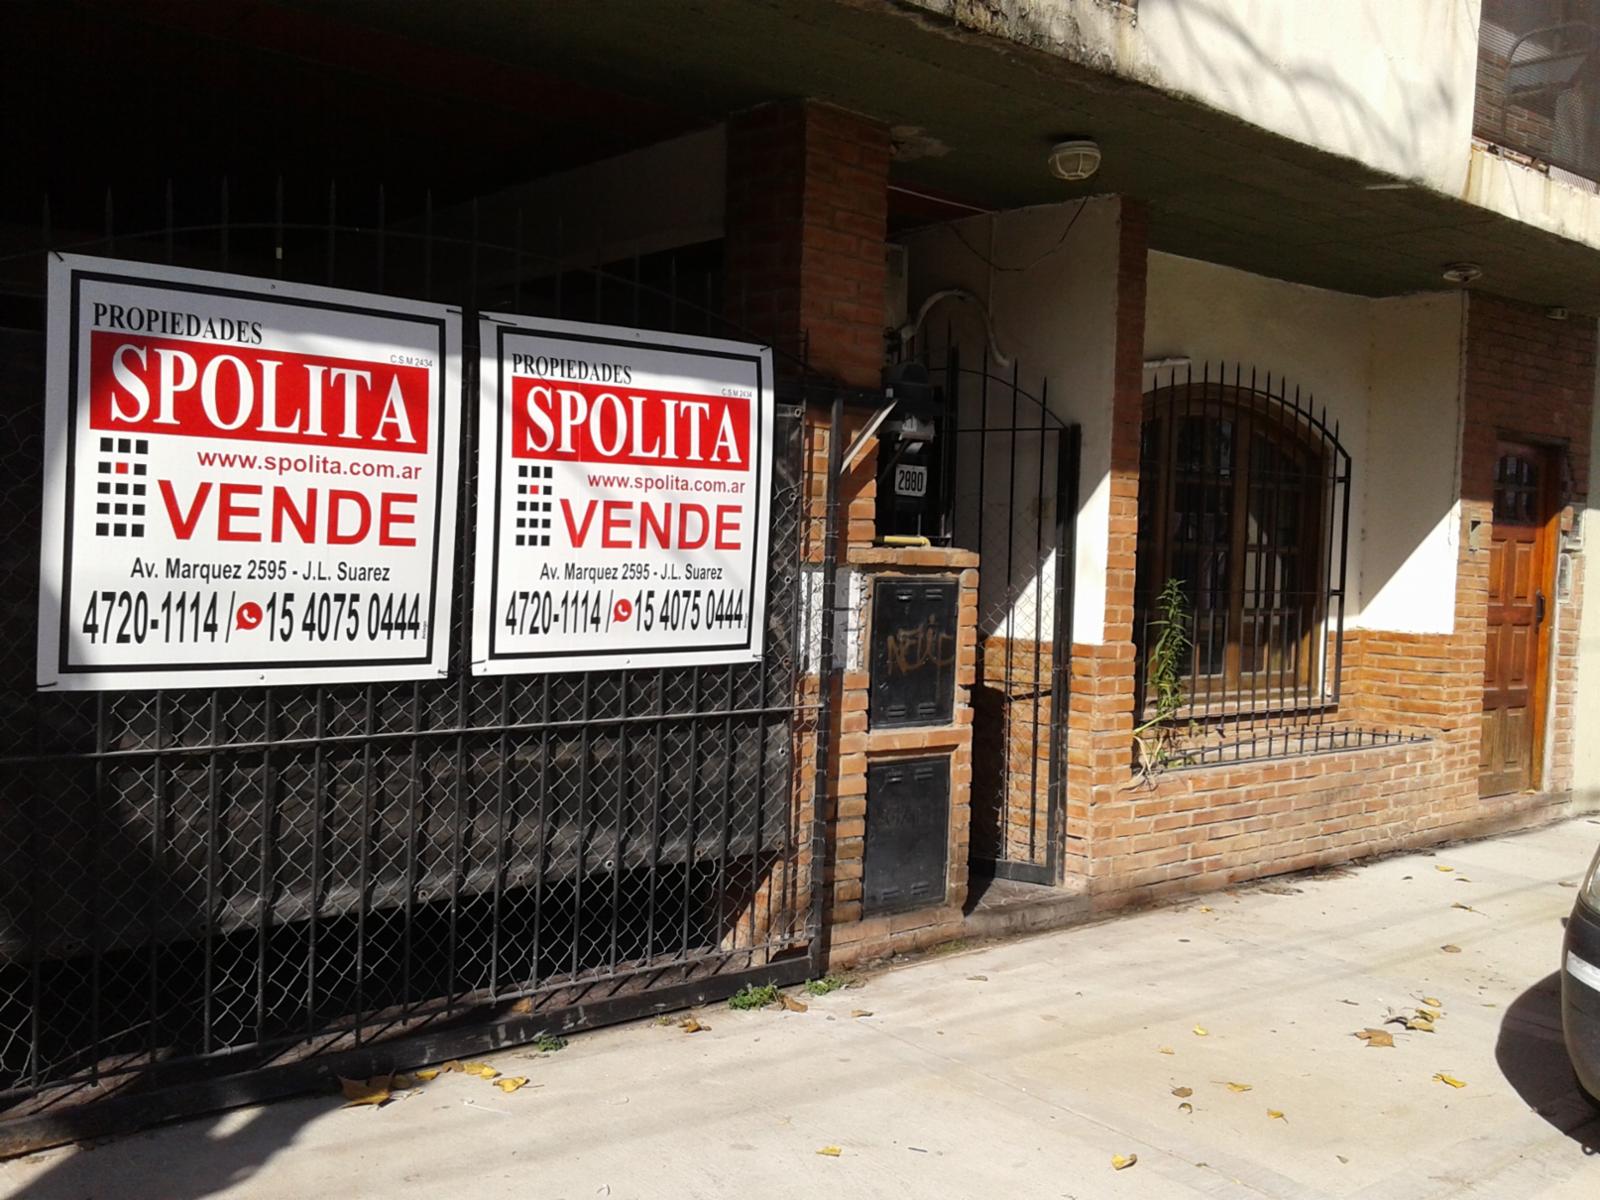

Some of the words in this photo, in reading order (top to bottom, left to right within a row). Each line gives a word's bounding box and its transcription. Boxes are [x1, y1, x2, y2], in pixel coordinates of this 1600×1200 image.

[93, 302, 263, 345] PROPIEDADES
[512, 353, 632, 384] PROPIEDADES
[110, 342, 417, 444] SPOLITA
[526, 385, 742, 463] SPOLITA
[197, 450, 422, 479] www.spolita.com.ar
[588, 474, 745, 494] www.spolita.com.ar
[898, 470, 923, 492] 2880
[157, 480, 418, 547] VENDE
[560, 498, 743, 550] VENDE
[130, 557, 159, 579] Av.
[166, 558, 242, 584] Marquez
[247, 560, 287, 581] 2595
[337, 561, 390, 582] Suarez
[540, 563, 560, 580] Av.
[564, 563, 618, 584] Marquez
[622, 563, 650, 580] 2595
[685, 563, 722, 580] Suarez
[82, 590, 218, 644] 4720-1114
[266, 592, 294, 642] 15
[301, 592, 360, 642] 4075
[367, 592, 421, 641] 0444
[505, 589, 601, 635] 4720-1114
[635, 589, 654, 631] 15
[659, 589, 700, 631] 4075
[705, 589, 744, 630] 0444
